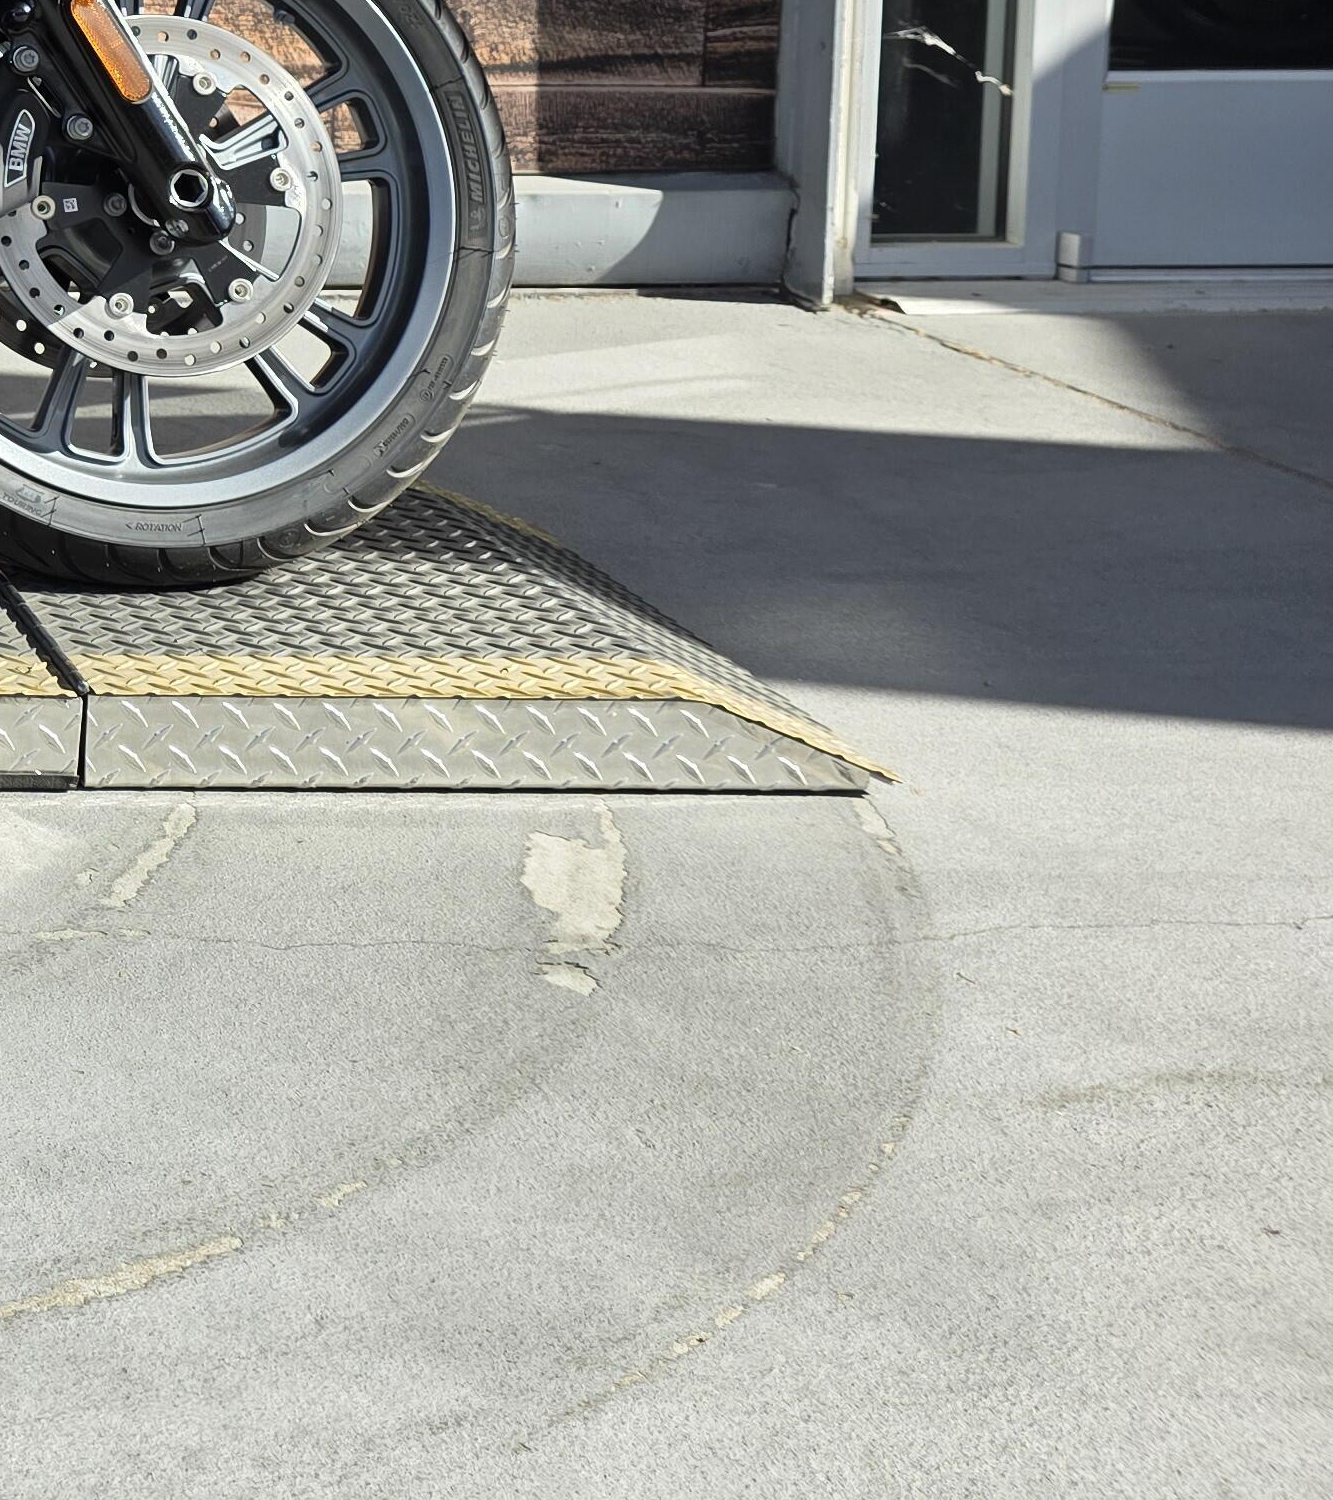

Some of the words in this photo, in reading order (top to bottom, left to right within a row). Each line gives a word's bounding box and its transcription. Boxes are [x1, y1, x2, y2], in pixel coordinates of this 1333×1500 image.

[9, 123, 31, 171] BMW
[448, 94, 484, 203] MICHELIN
[3, 492, 42, 516] TOURING
[135, 522, 182, 532] ROTATION
